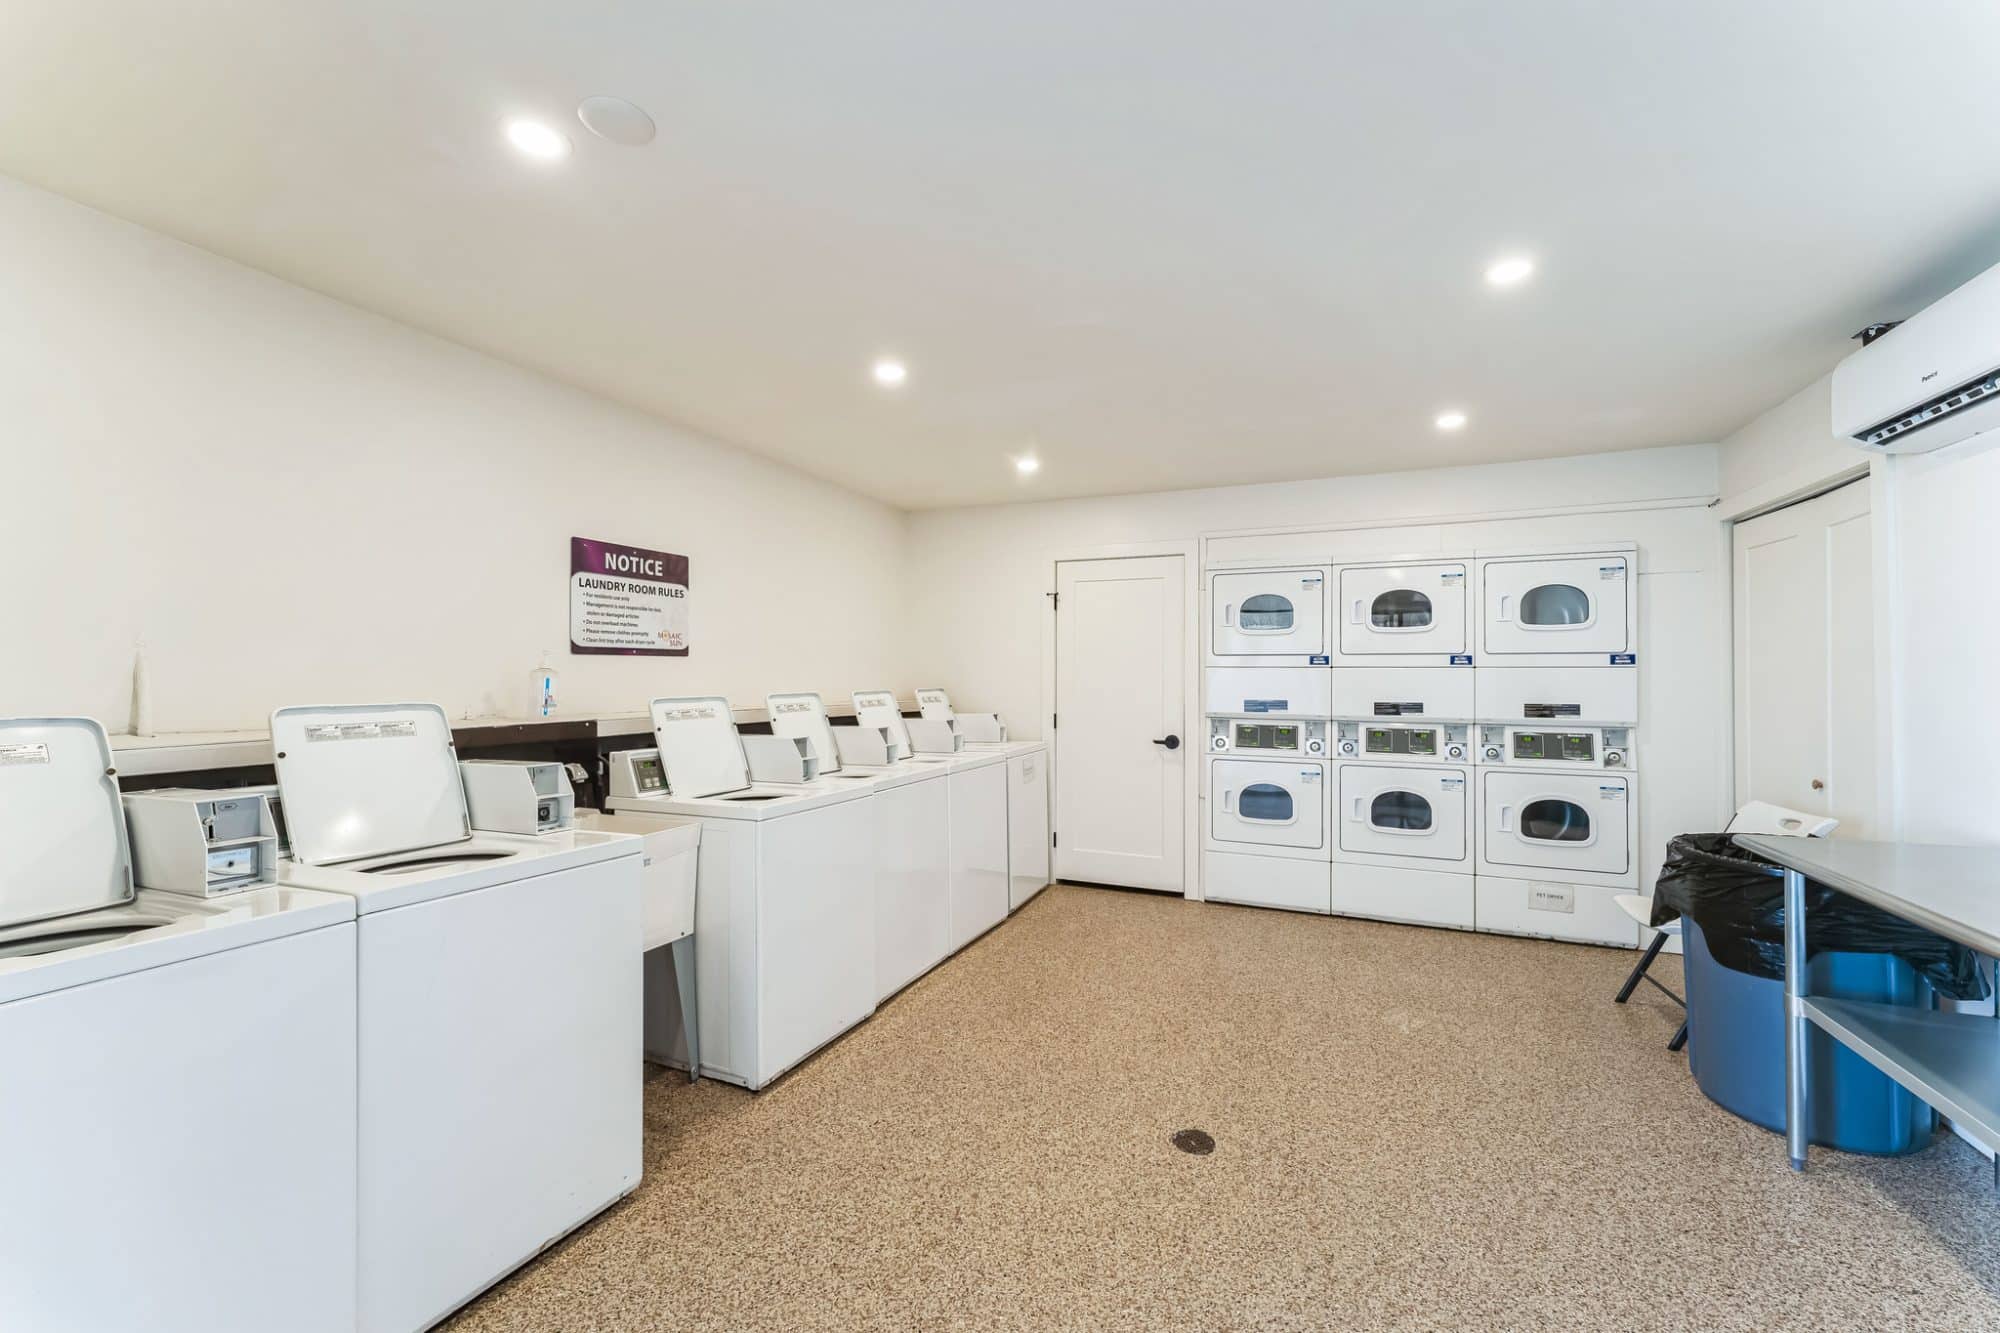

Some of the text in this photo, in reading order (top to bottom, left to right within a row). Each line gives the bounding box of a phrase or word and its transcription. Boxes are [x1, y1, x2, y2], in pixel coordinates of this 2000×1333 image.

[604, 552, 663, 577] NOTICE
[578, 577, 685, 599] LAUNDRY ROOM RULES
